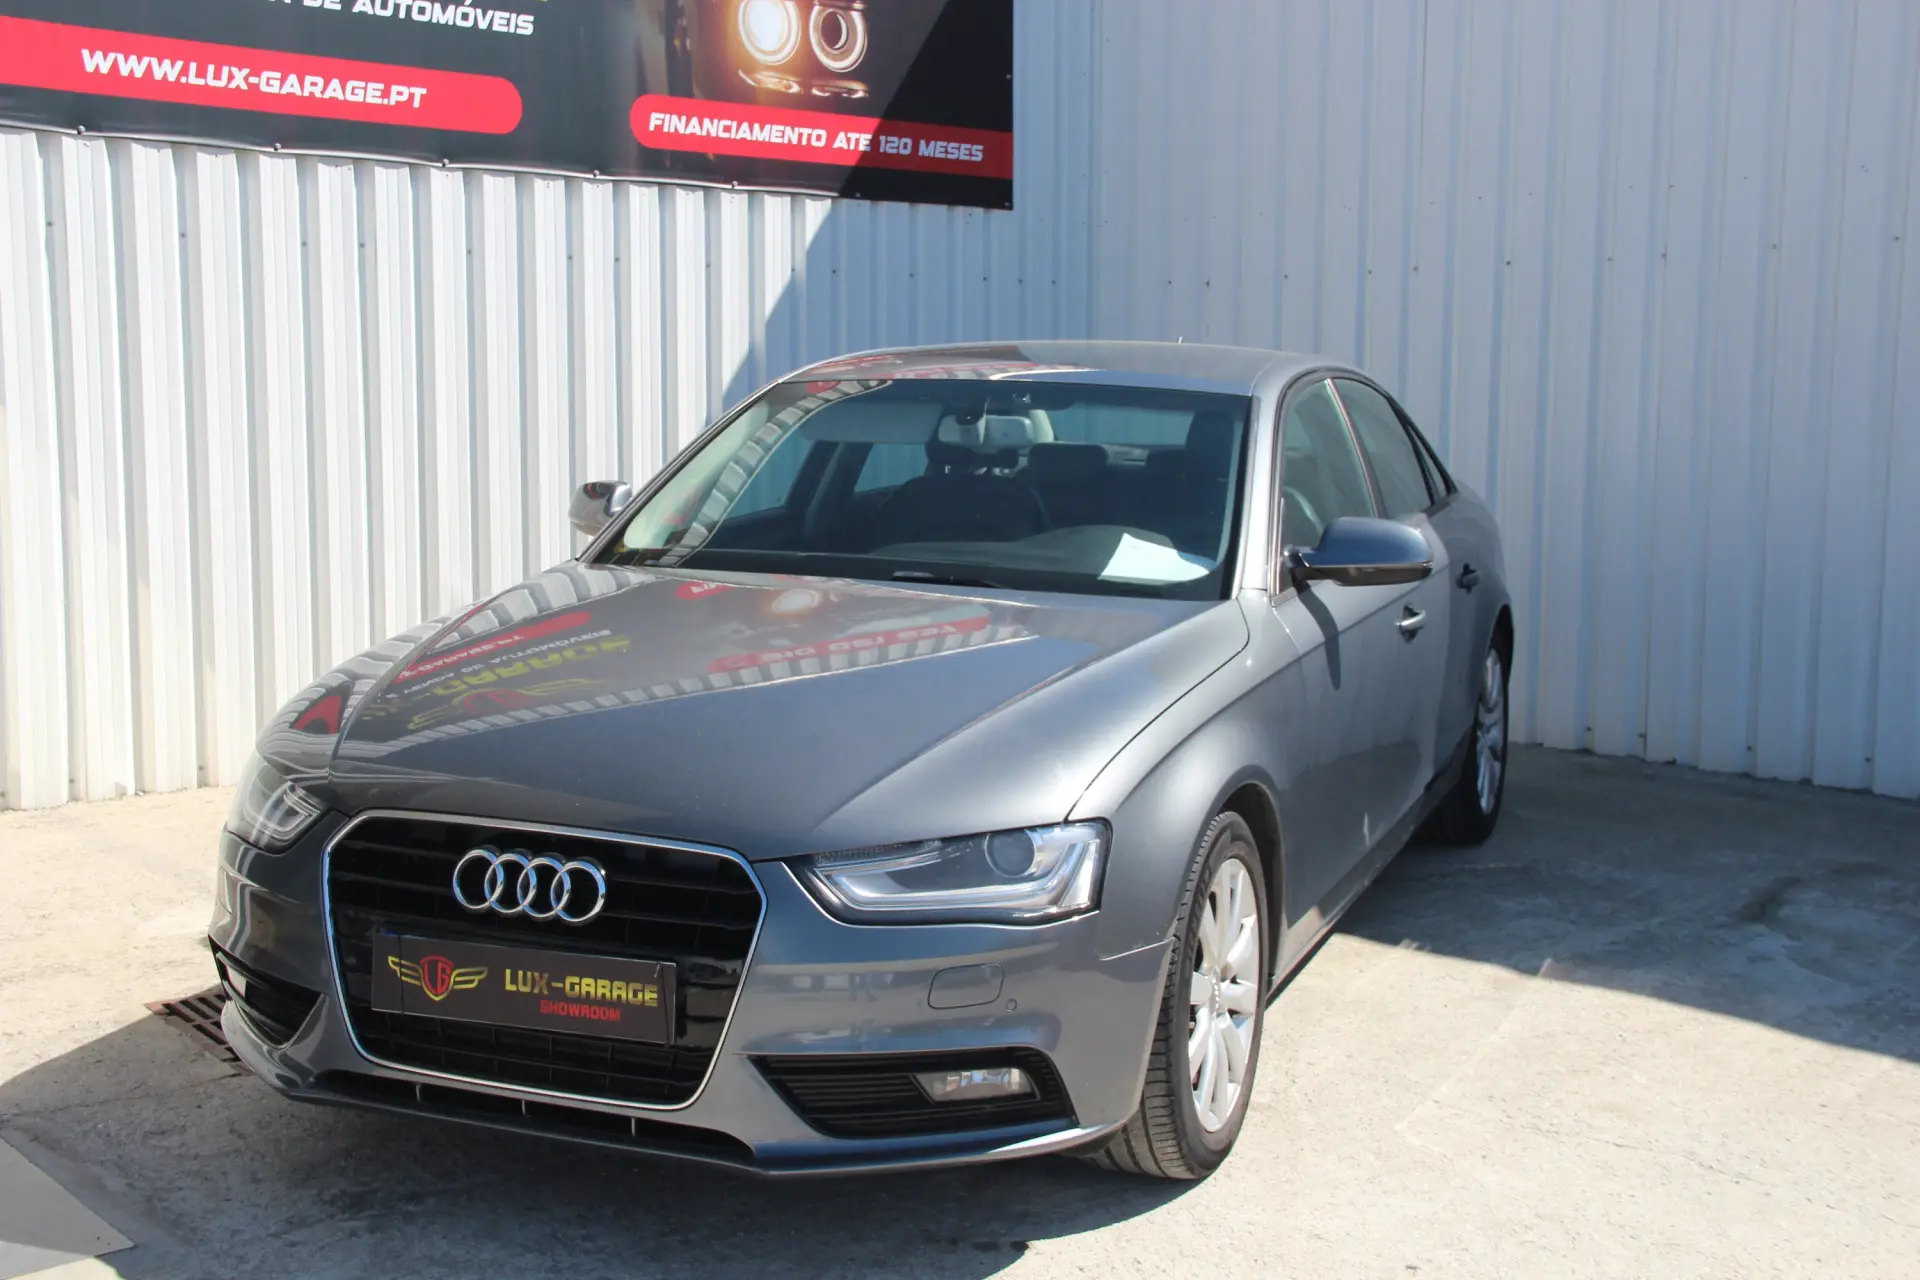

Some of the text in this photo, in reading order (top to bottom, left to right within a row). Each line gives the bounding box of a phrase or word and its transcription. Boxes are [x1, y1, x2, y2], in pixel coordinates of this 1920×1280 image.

[352, 0, 534, 36] AUTOMÓVEIS
[81, 48, 428, 108] WWW.LUX-GARAGE.PT
[649, 112, 984, 161] FINANCIAMENTO ATE 120 MESES
[505, 968, 658, 1007] LUX-GARAGE
[539, 999, 622, 1021] SHOWROOM
